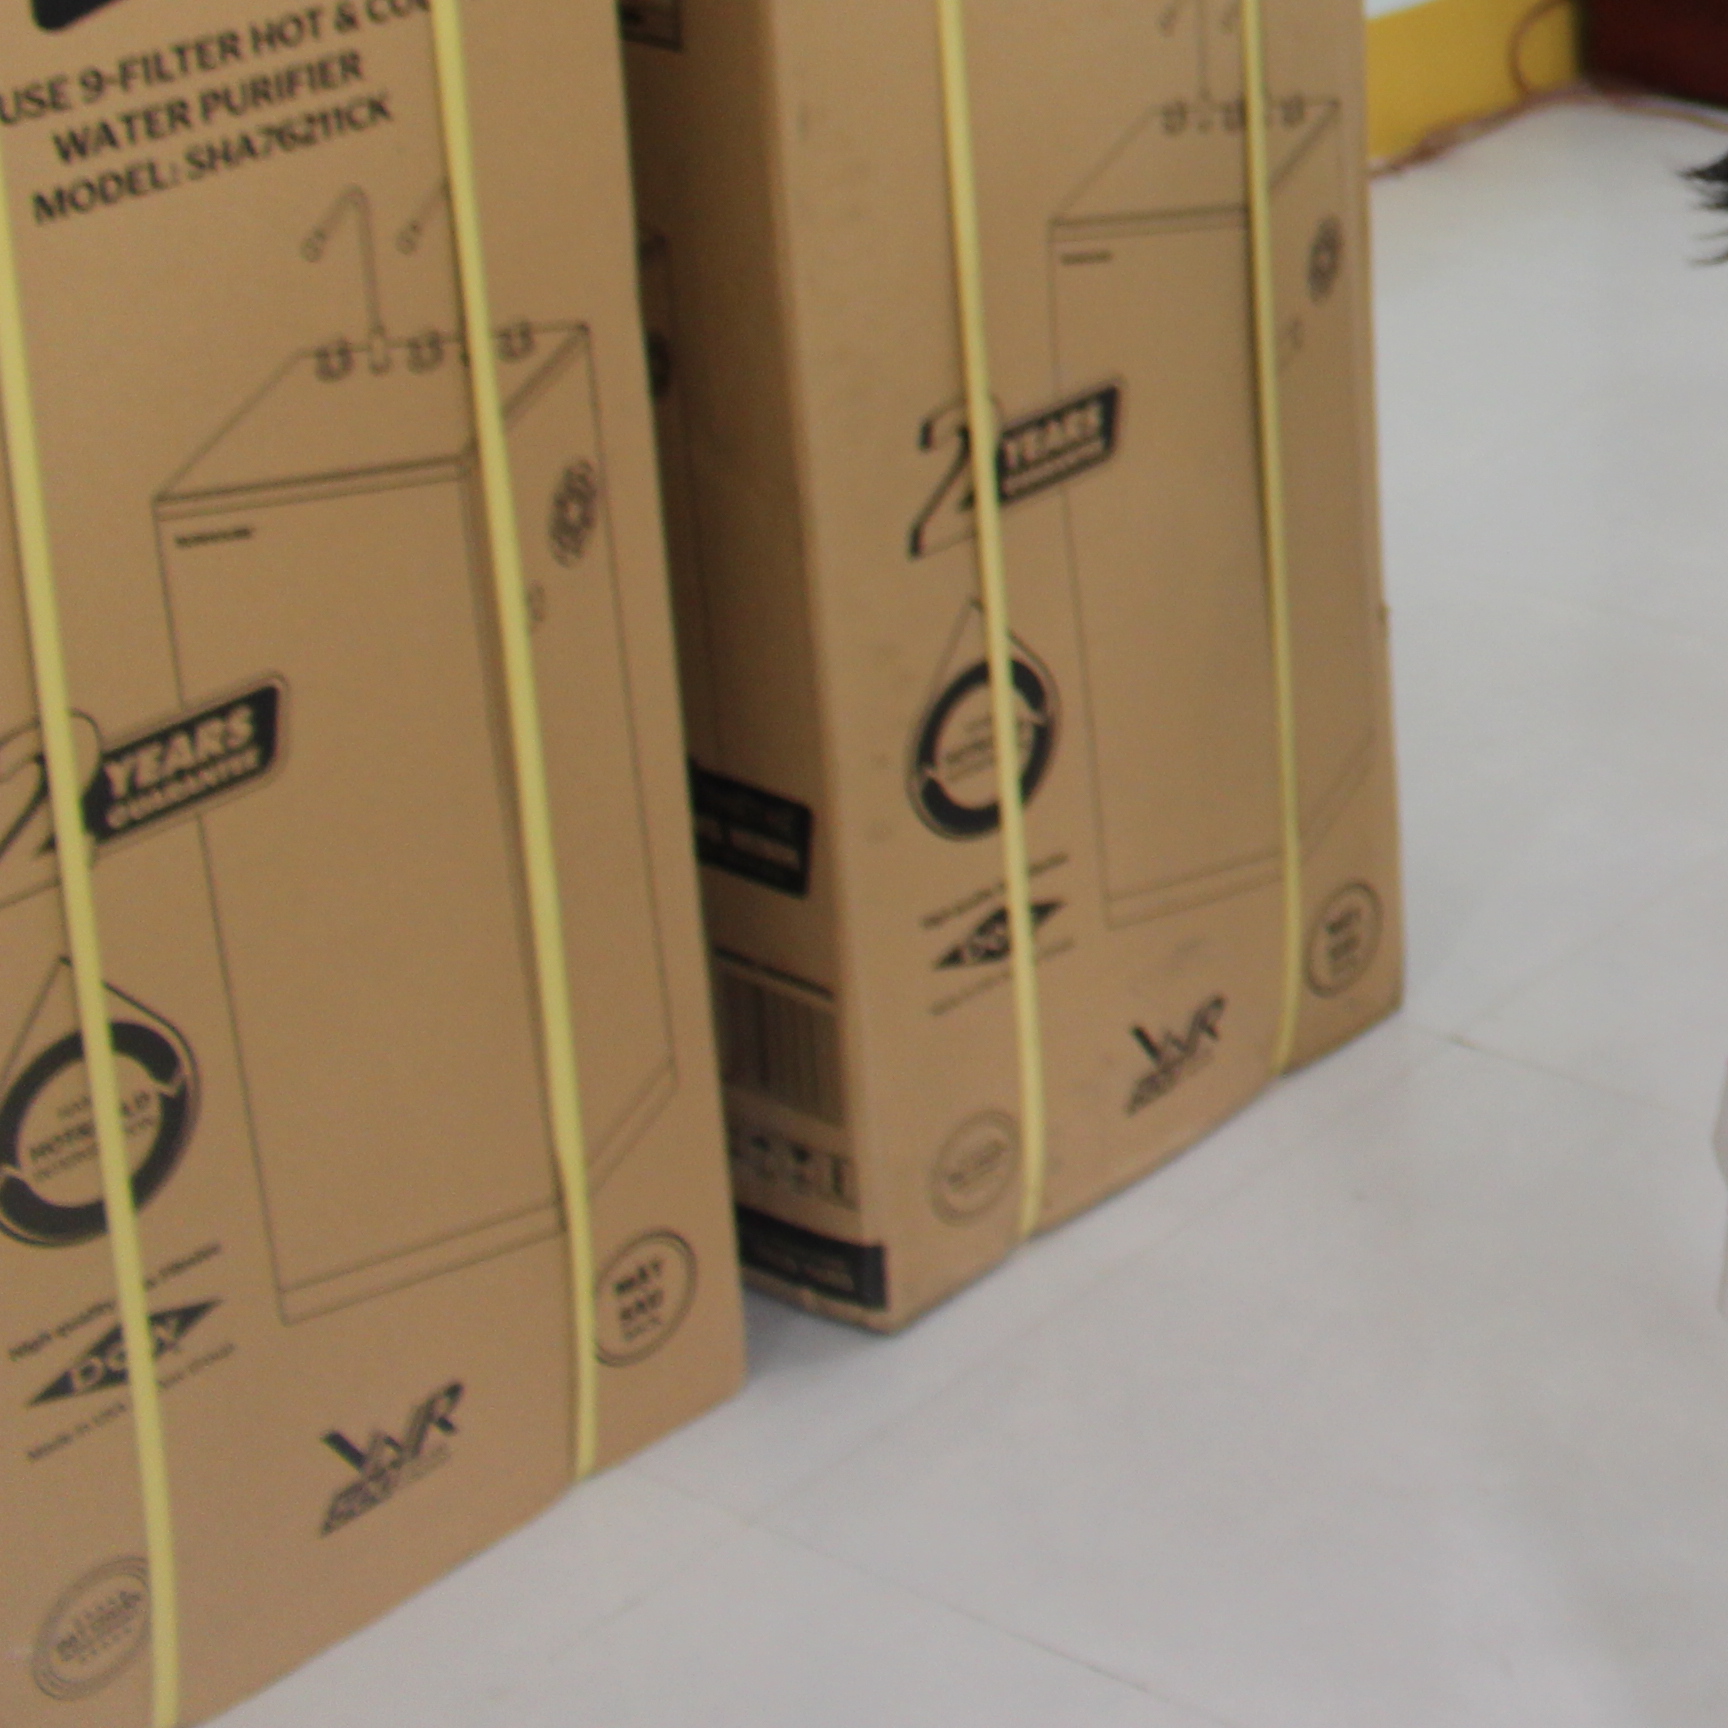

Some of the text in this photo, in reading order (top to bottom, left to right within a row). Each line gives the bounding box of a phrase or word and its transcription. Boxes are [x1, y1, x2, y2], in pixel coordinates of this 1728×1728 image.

[78, 29, 243, 104] 9-FILTER
[250, 4, 322, 54] HOT
[53, 49, 362, 166] WATER PURIFIER
[32, 160, 180, 223] MODEL:
[1003, 404, 1098, 470] YEARS
[103, 705, 255, 804] YEARS
